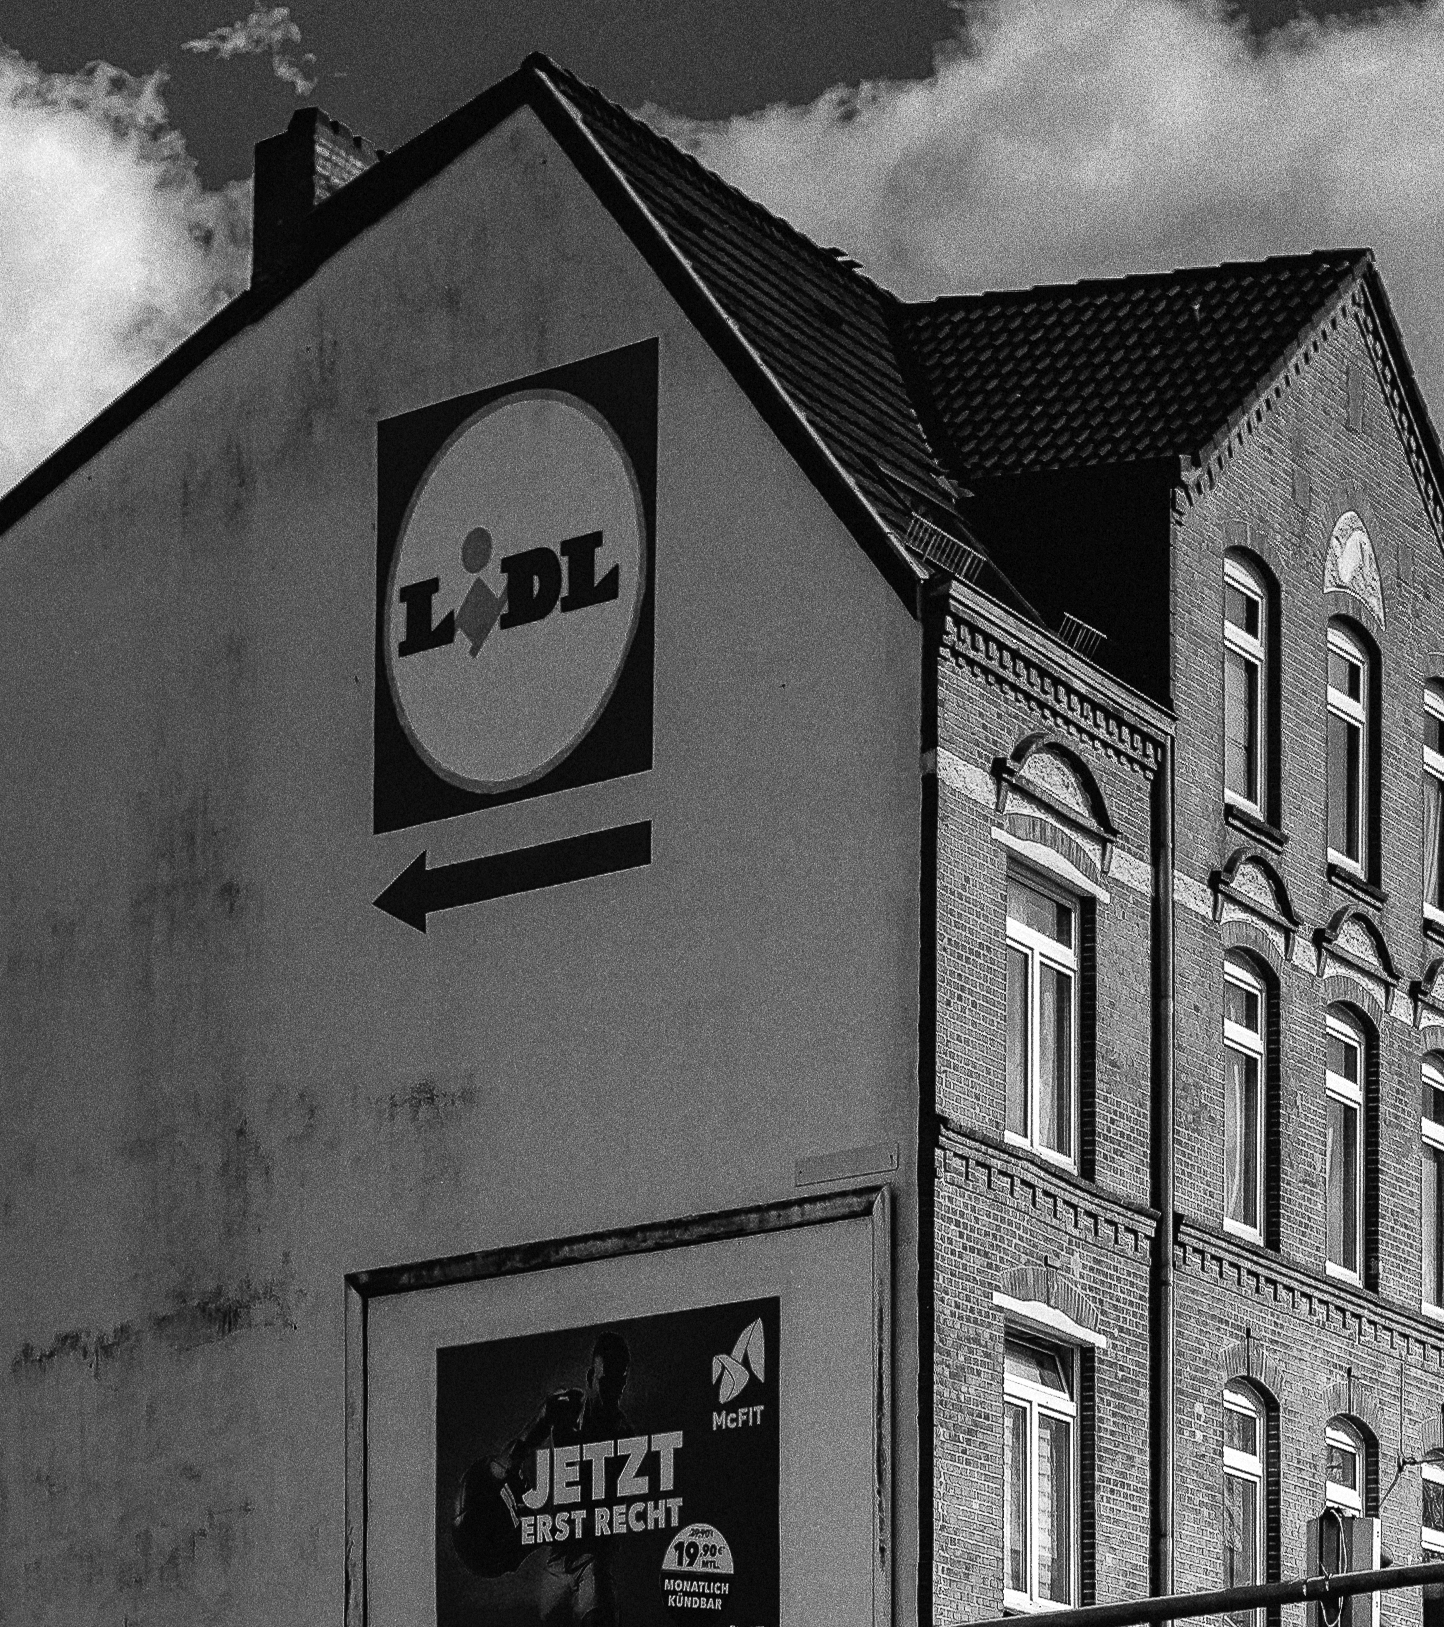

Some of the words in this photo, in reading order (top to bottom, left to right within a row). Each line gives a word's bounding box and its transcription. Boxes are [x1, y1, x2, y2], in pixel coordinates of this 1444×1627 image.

[712, 1405, 765, 1431] McFIT
[521, 1430, 683, 1509] JETZT
[521, 1510, 587, 1545] ERST
[595, 1498, 683, 1536] RECHT
[664, 1579, 729, 1594] MONATLICH
[668, 1592, 722, 1610] KÜNDBAR
